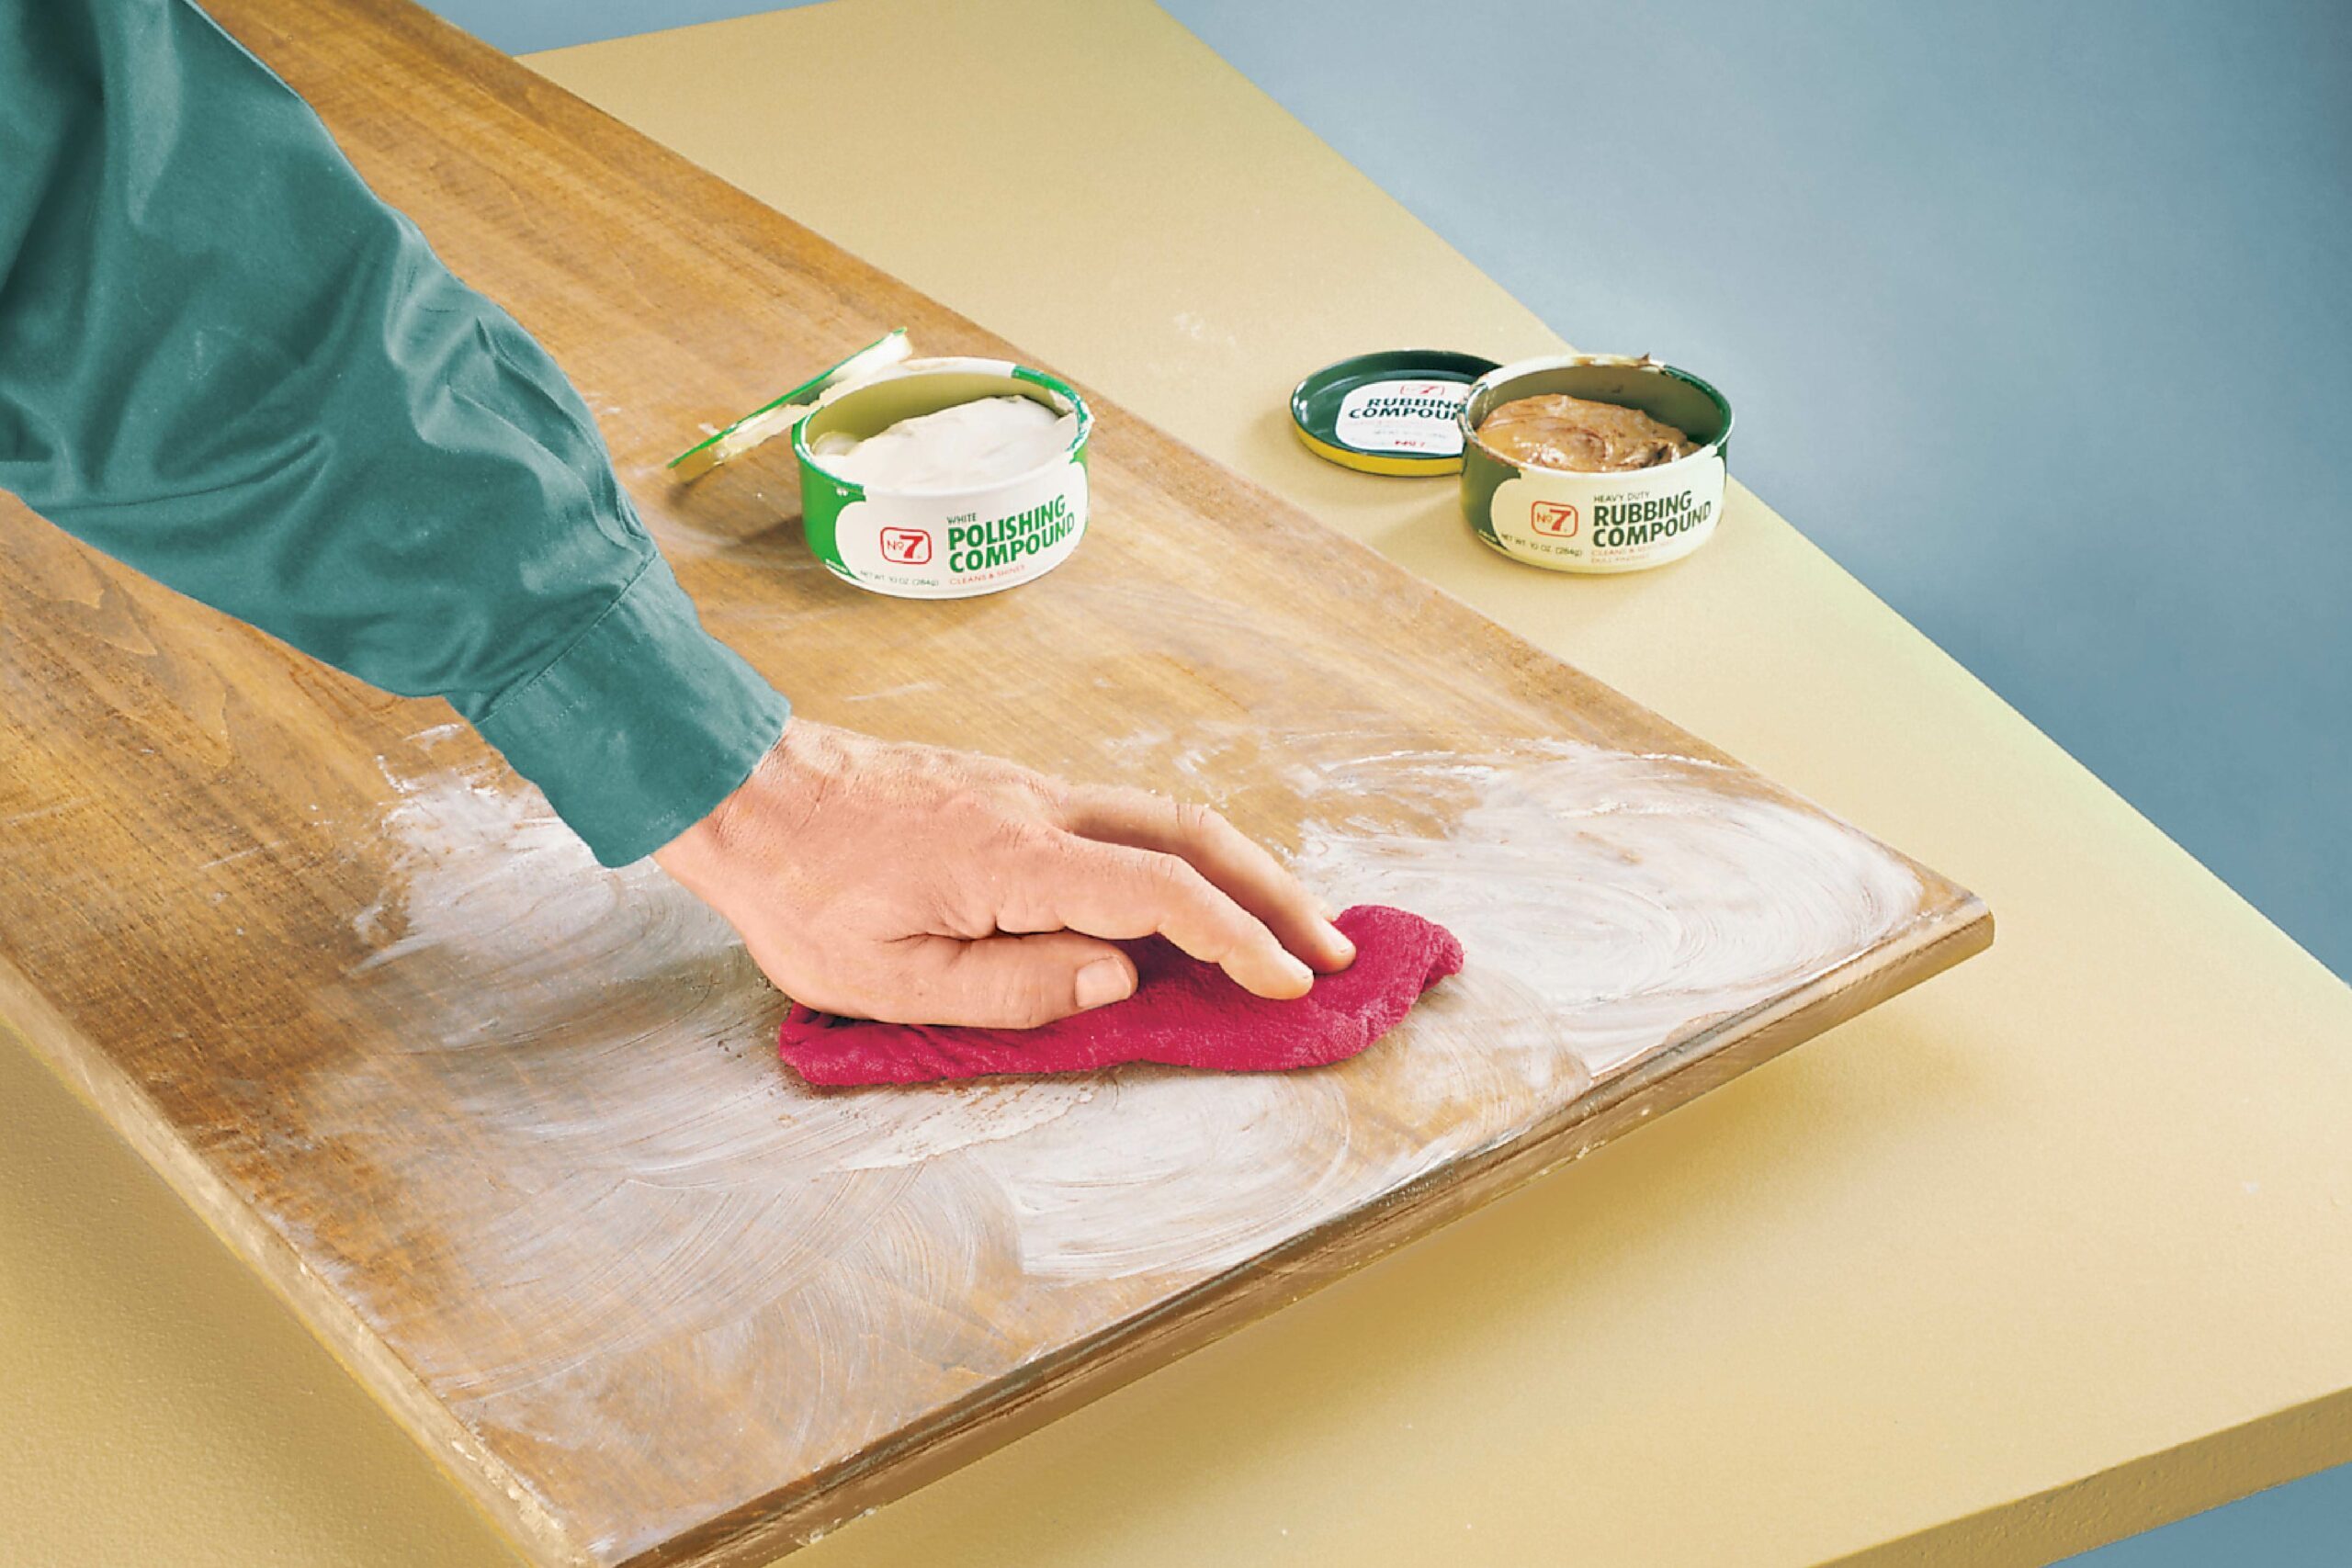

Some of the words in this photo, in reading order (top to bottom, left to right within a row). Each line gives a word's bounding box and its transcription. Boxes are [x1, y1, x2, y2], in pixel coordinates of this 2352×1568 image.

[1349, 408, 1457, 421] COMPOU
[1594, 493, 1623, 503] HEAVY
[1628, 491, 1650, 500] DUTY
[946, 513, 977, 525] WHITE
[1549, 509, 1571, 531] 7
[1593, 491, 1692, 527] RUBBING
[947, 494, 1066, 550] POLISHING
[1593, 501, 1712, 548] COMPOUND
[899, 534, 923, 558] 7
[949, 512, 1075, 573] COMPOUND
[950, 574, 986, 585] CLEANS
